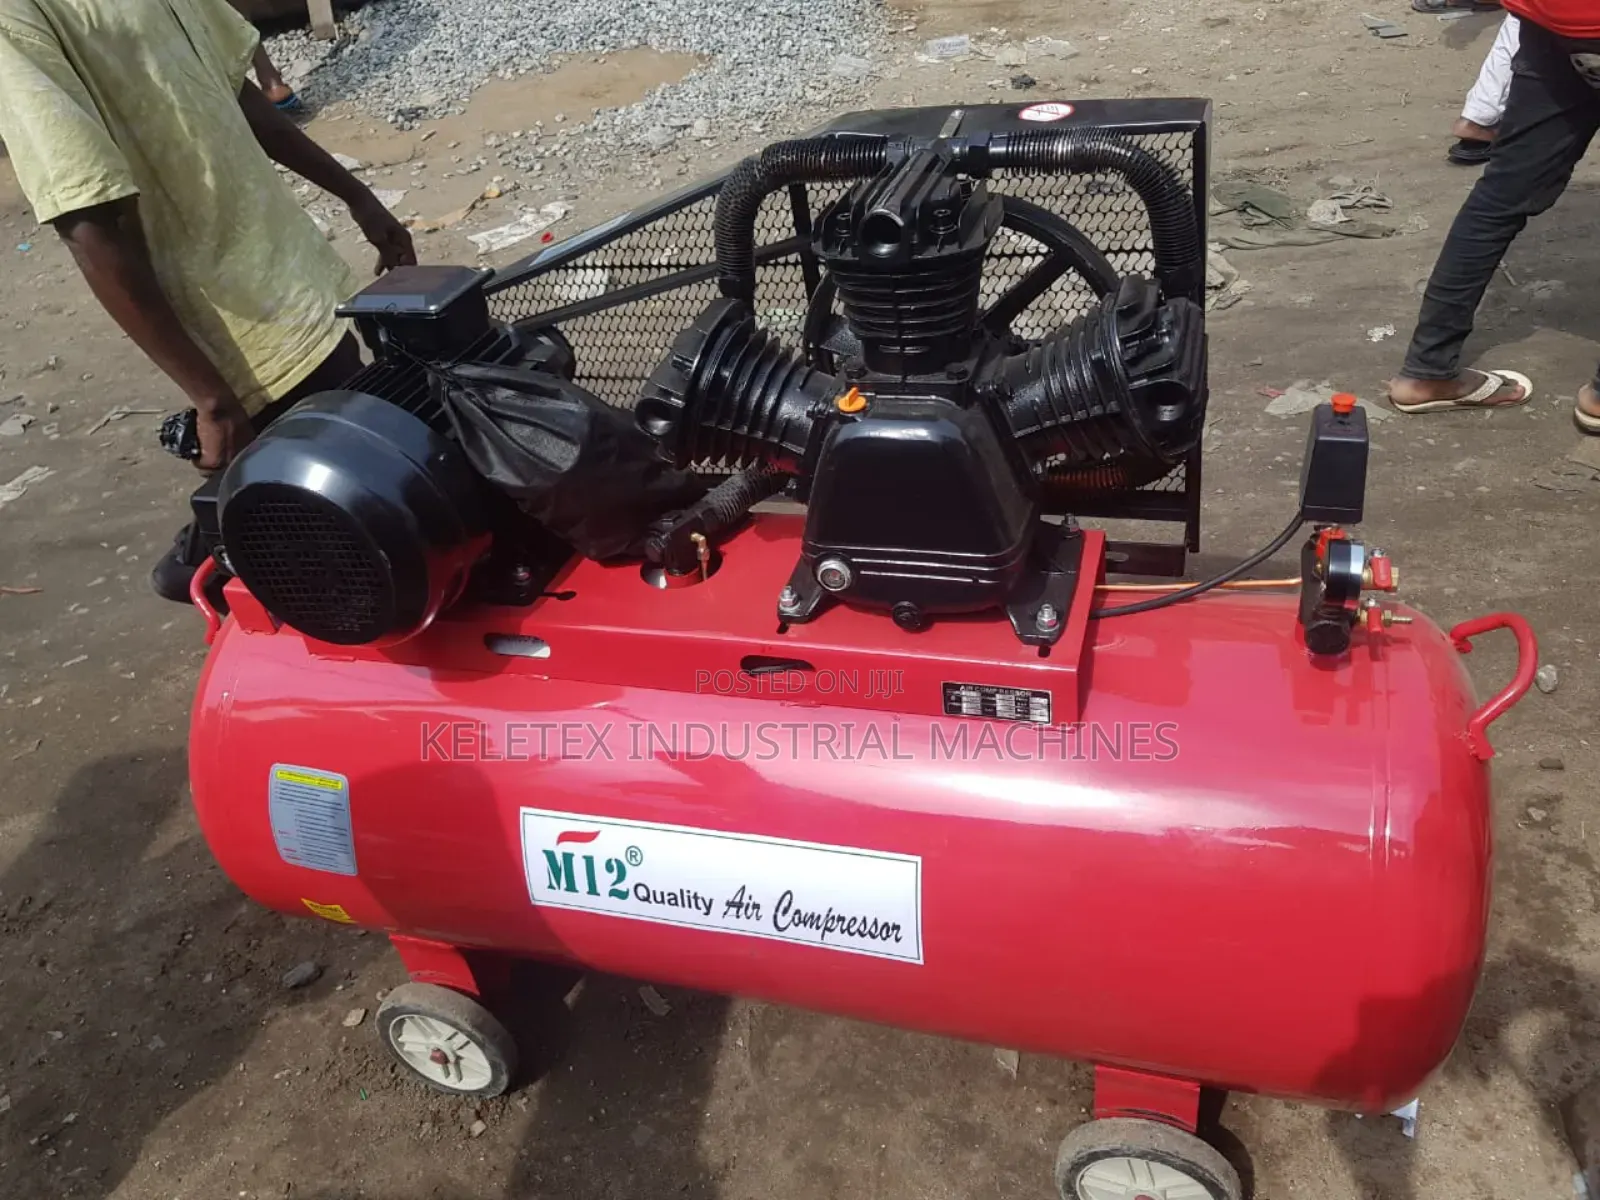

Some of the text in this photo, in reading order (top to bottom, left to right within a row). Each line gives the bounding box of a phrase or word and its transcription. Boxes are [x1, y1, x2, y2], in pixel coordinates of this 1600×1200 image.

[633, 882, 904, 944] Quality Air Compressor
